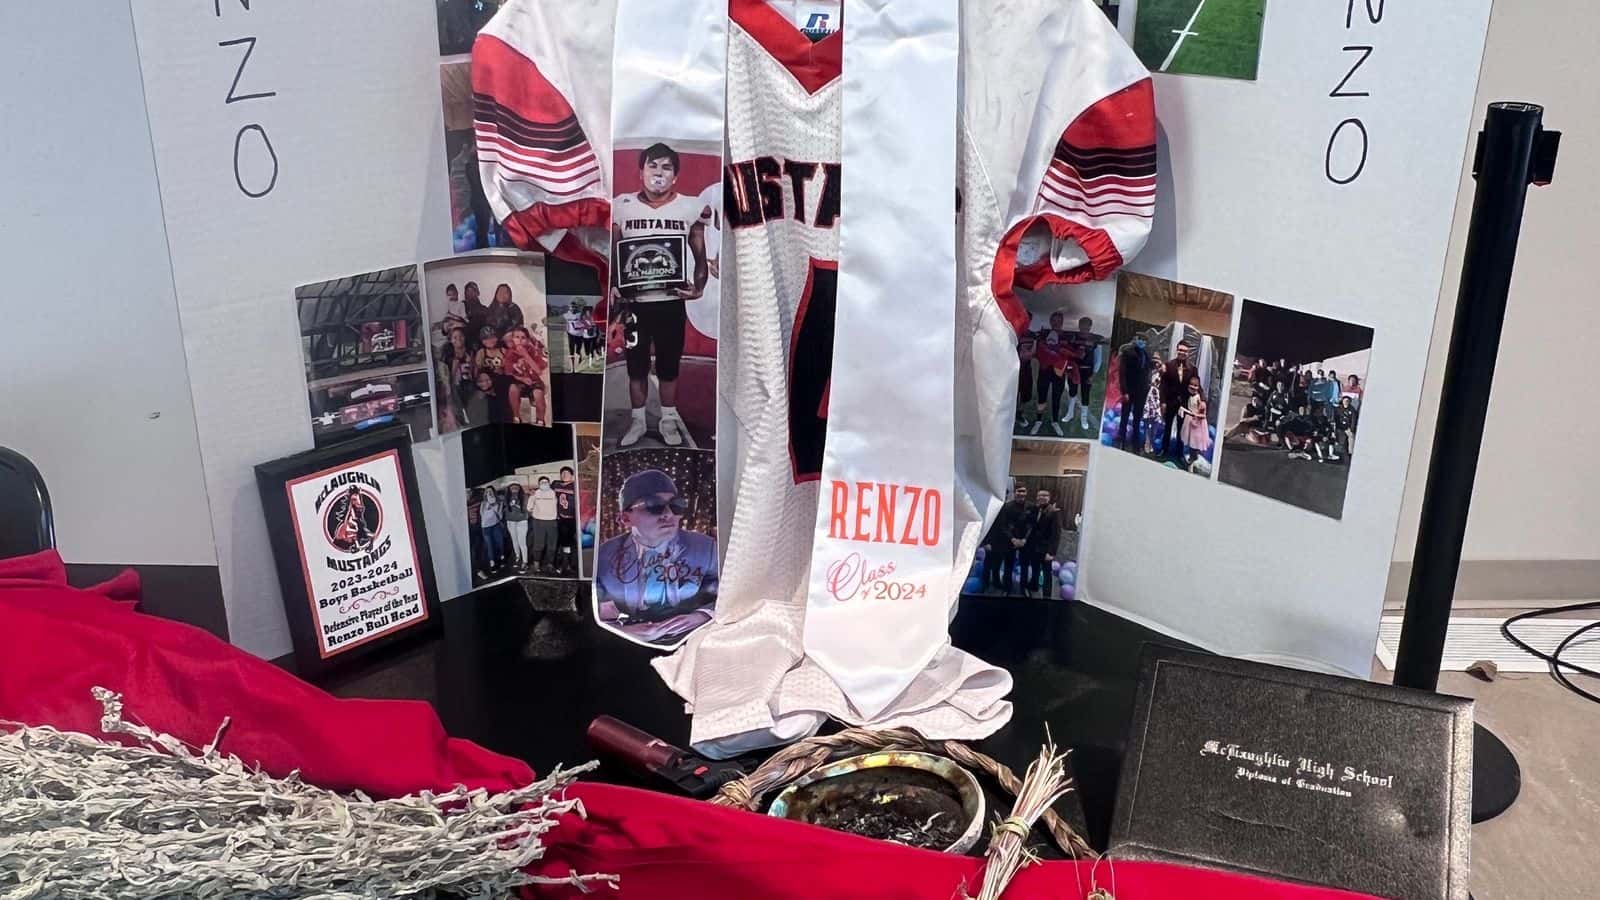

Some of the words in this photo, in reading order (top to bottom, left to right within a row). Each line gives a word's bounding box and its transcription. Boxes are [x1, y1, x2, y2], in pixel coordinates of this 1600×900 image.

[827, 480, 941, 546] RENZO
[326, 535, 392, 572] MUSTANGS
[319, 595, 348, 610] Boys
[350, 568, 413, 598] Basketball
[331, 561, 398, 593] 2023-2024
[826, 552, 896, 601] Class
[874, 580, 928, 600] 2024
[327, 628, 364, 647] Renzo
[366, 616, 389, 633] Bull
[391, 604, 420, 621] Head
[1200, 740, 1290, 767] McLaughlin
[1296, 757, 1334, 780] High
[1341, 766, 1393, 788] School
[1296, 778, 1352, 797] Graduation
